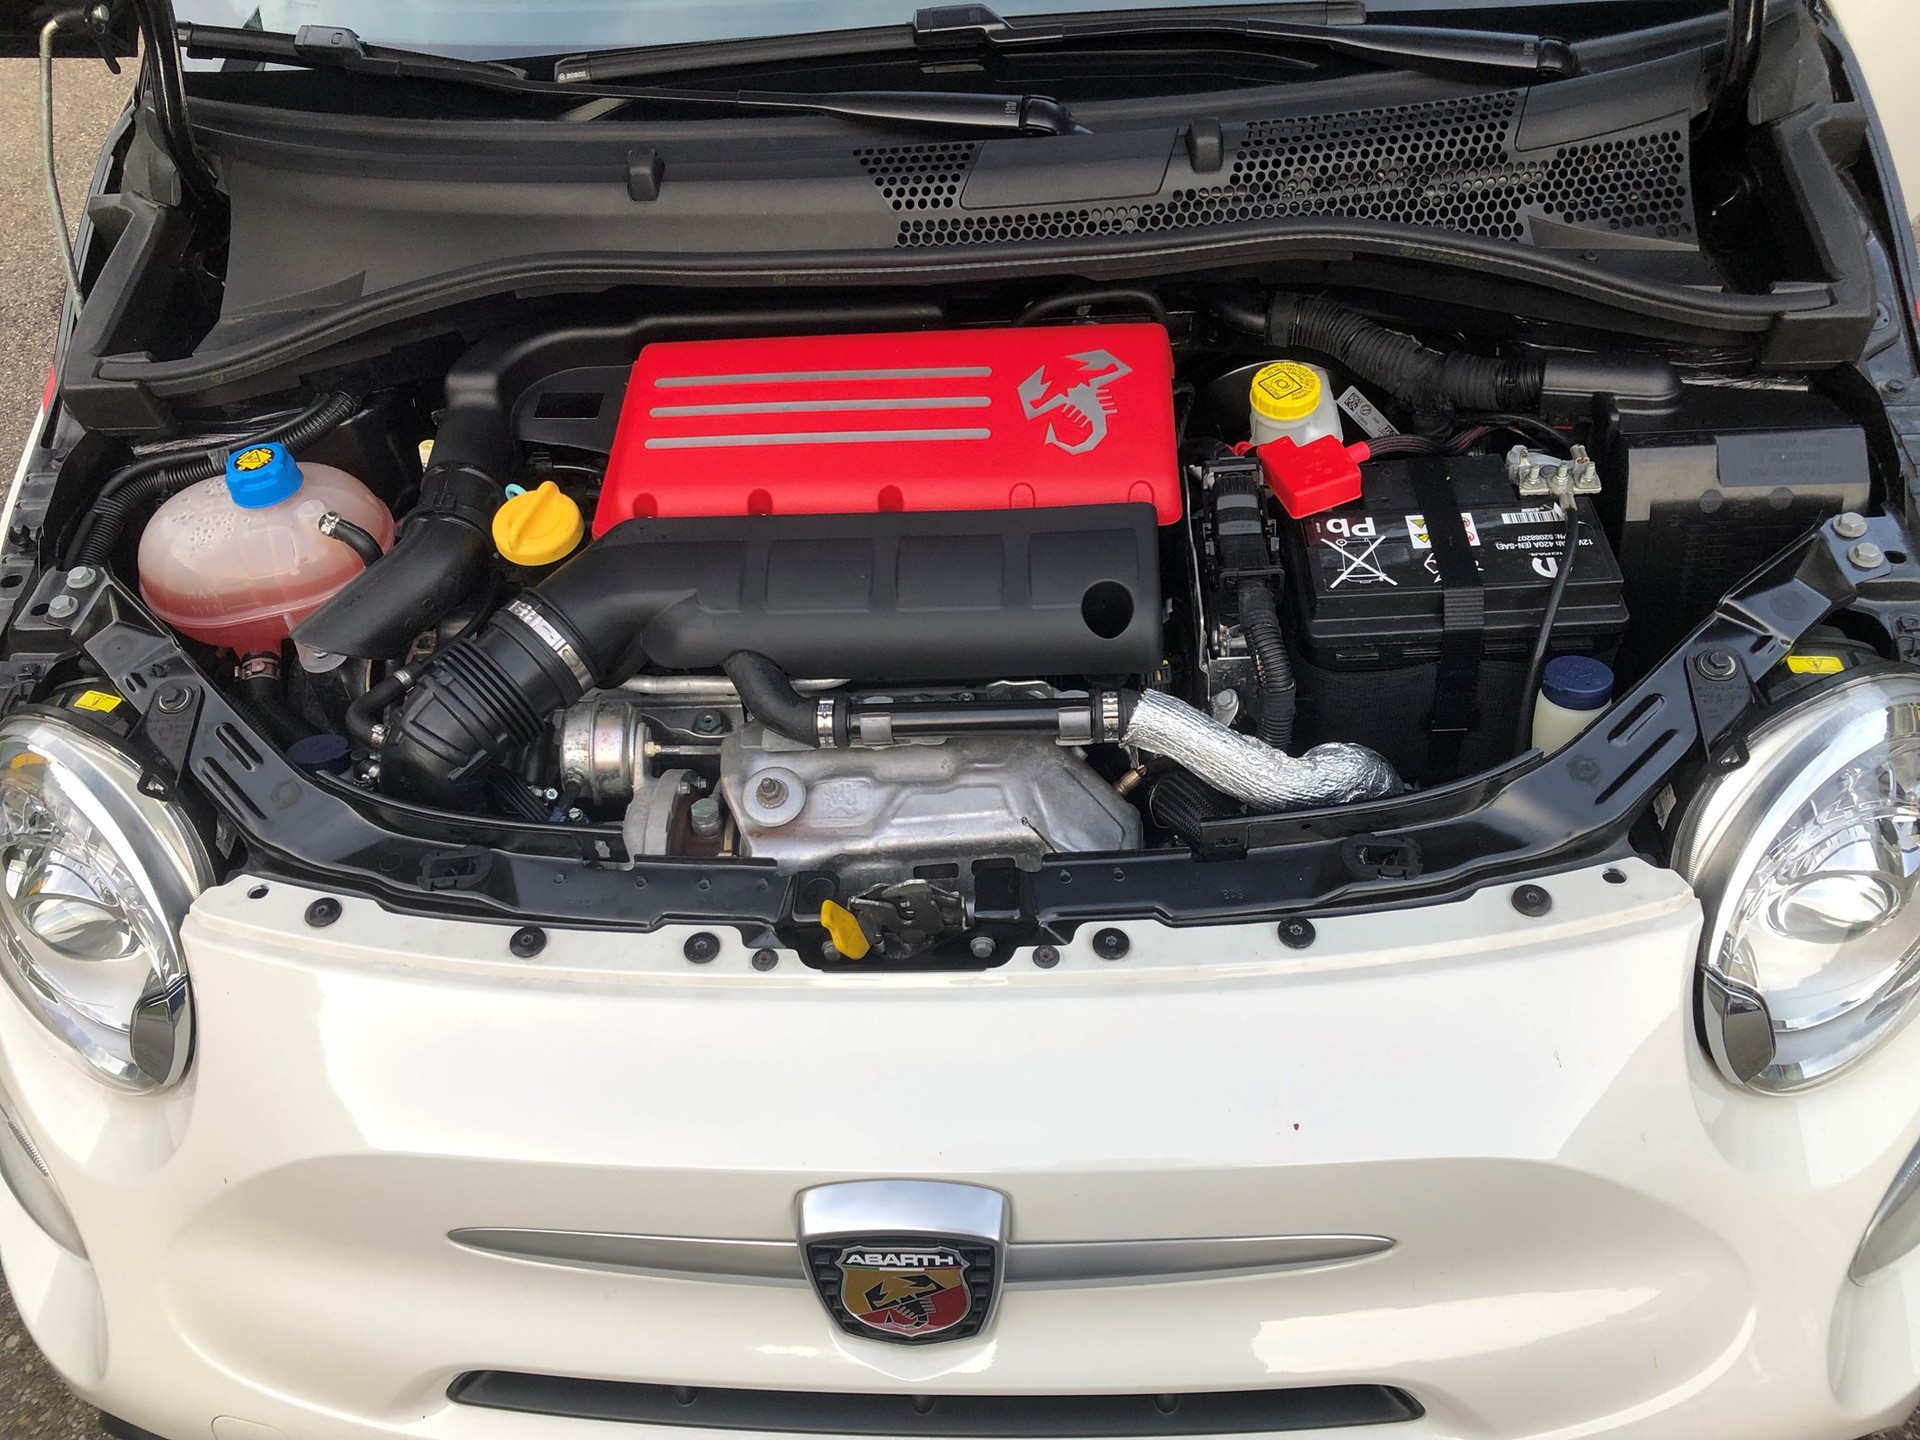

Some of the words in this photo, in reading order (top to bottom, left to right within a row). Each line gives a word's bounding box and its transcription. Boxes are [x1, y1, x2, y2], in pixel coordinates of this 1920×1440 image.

[1326, 517, 1376, 538] Pb
[1495, 542, 1532, 550] (EN-SAE)
[1533, 541, 1554, 549] 420A
[846, 1253, 954, 1266] ABARTH
